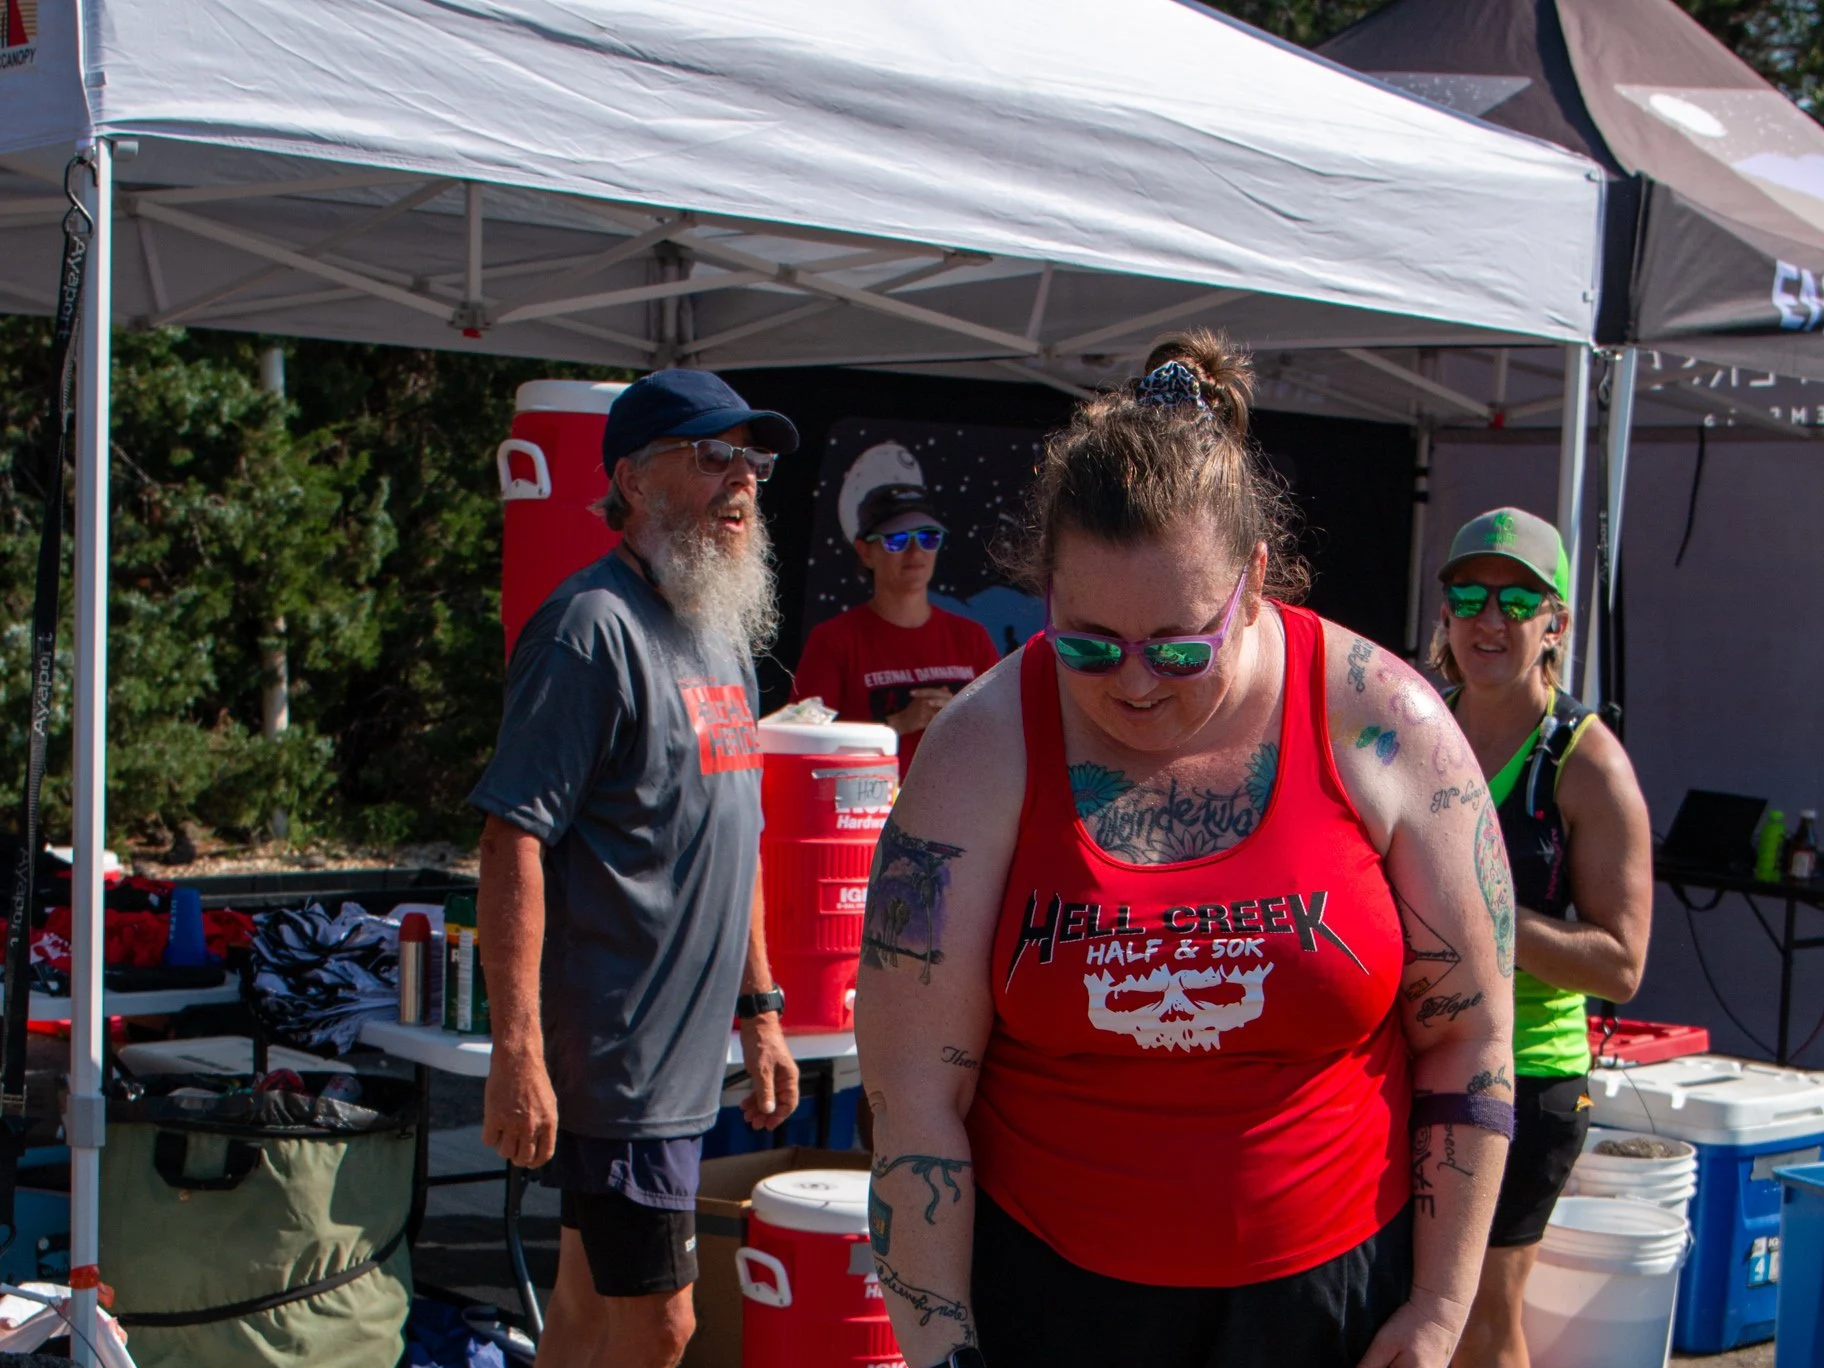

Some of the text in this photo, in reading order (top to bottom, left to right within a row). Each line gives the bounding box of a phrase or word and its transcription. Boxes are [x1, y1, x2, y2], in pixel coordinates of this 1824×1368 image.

[56, 235, 86, 340] Ayaport
[864, 669, 914, 688] ETERNAL
[1005, 889, 1370, 994] HELL CREEK
[1086, 938, 1266, 966] HALF & 50K
